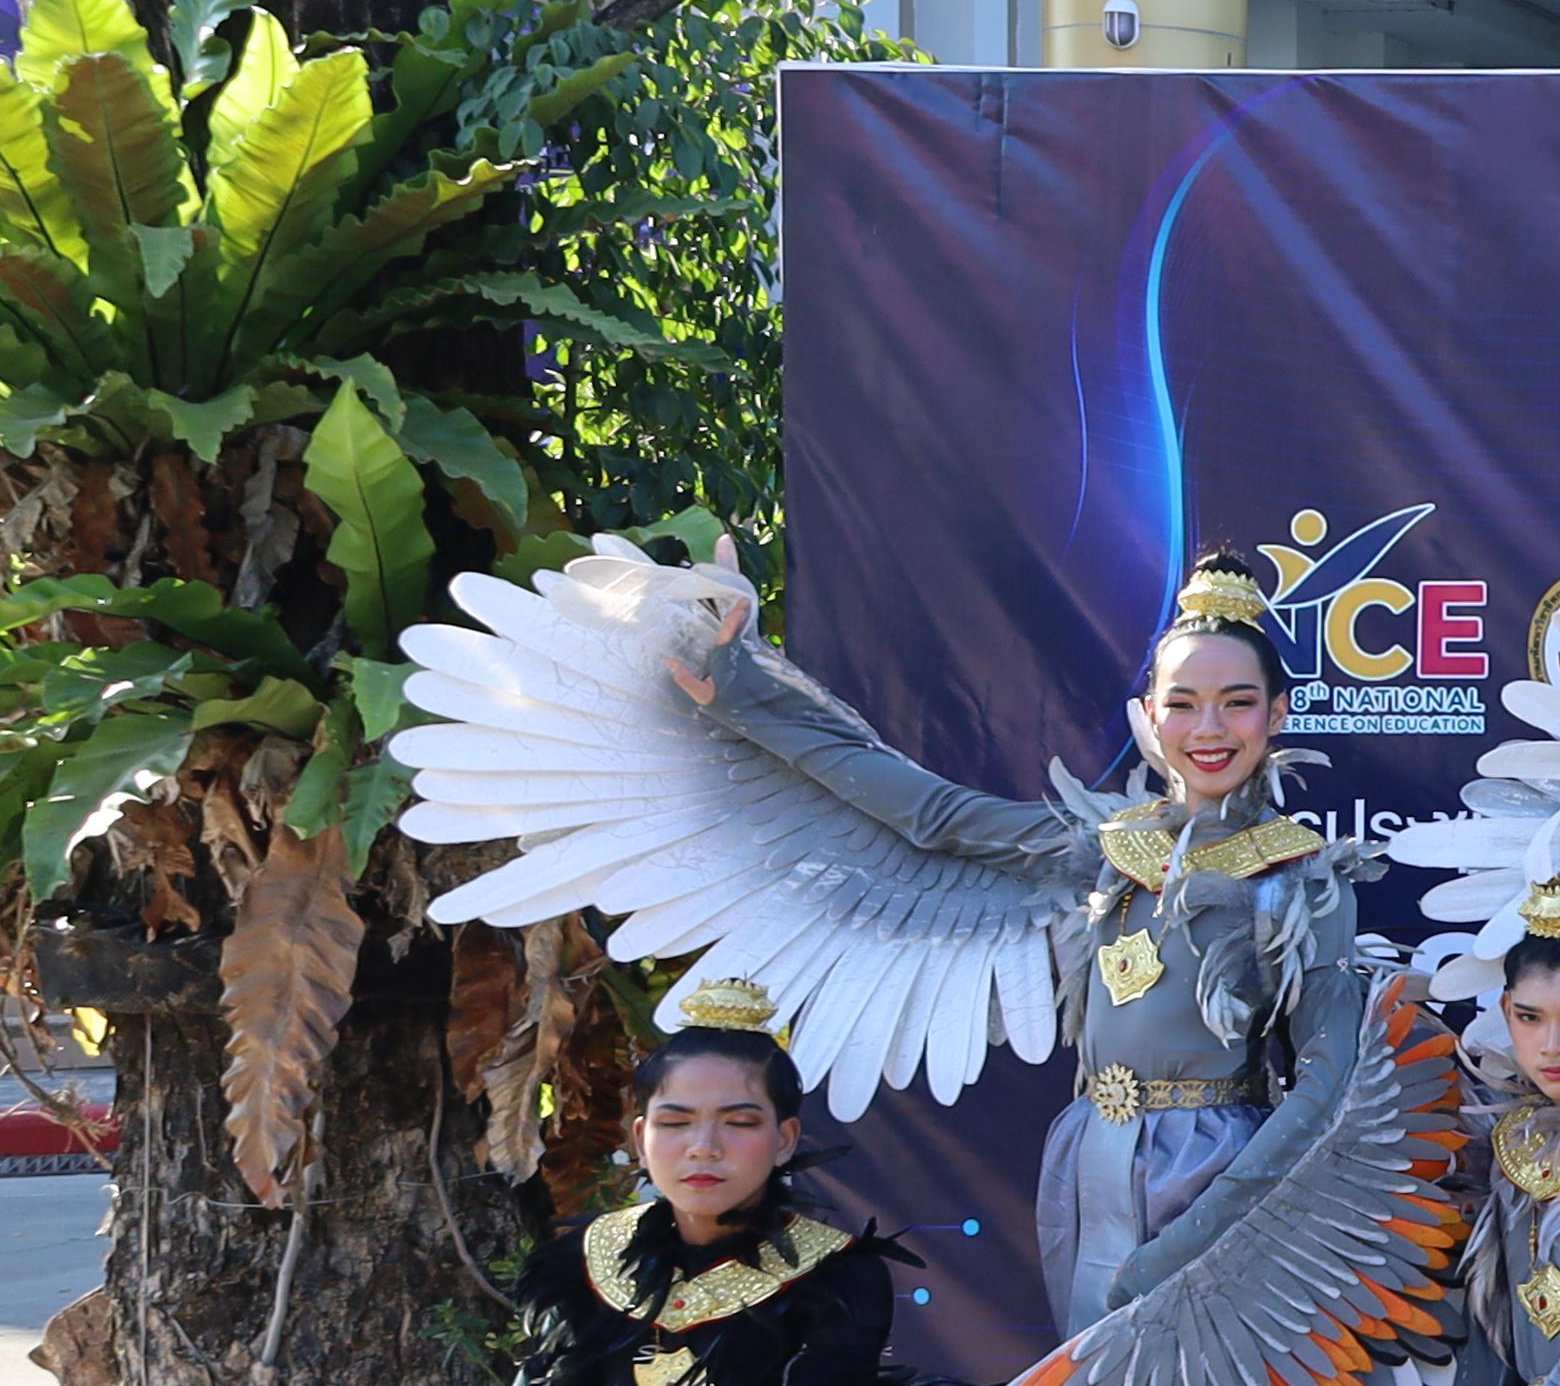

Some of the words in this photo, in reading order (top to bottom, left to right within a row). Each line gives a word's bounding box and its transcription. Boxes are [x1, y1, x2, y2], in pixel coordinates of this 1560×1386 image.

[1335, 687, 1484, 712] NATIONAL
[1352, 717, 1379, 732] ON
[1385, 717, 1484, 732] EDUCATION
